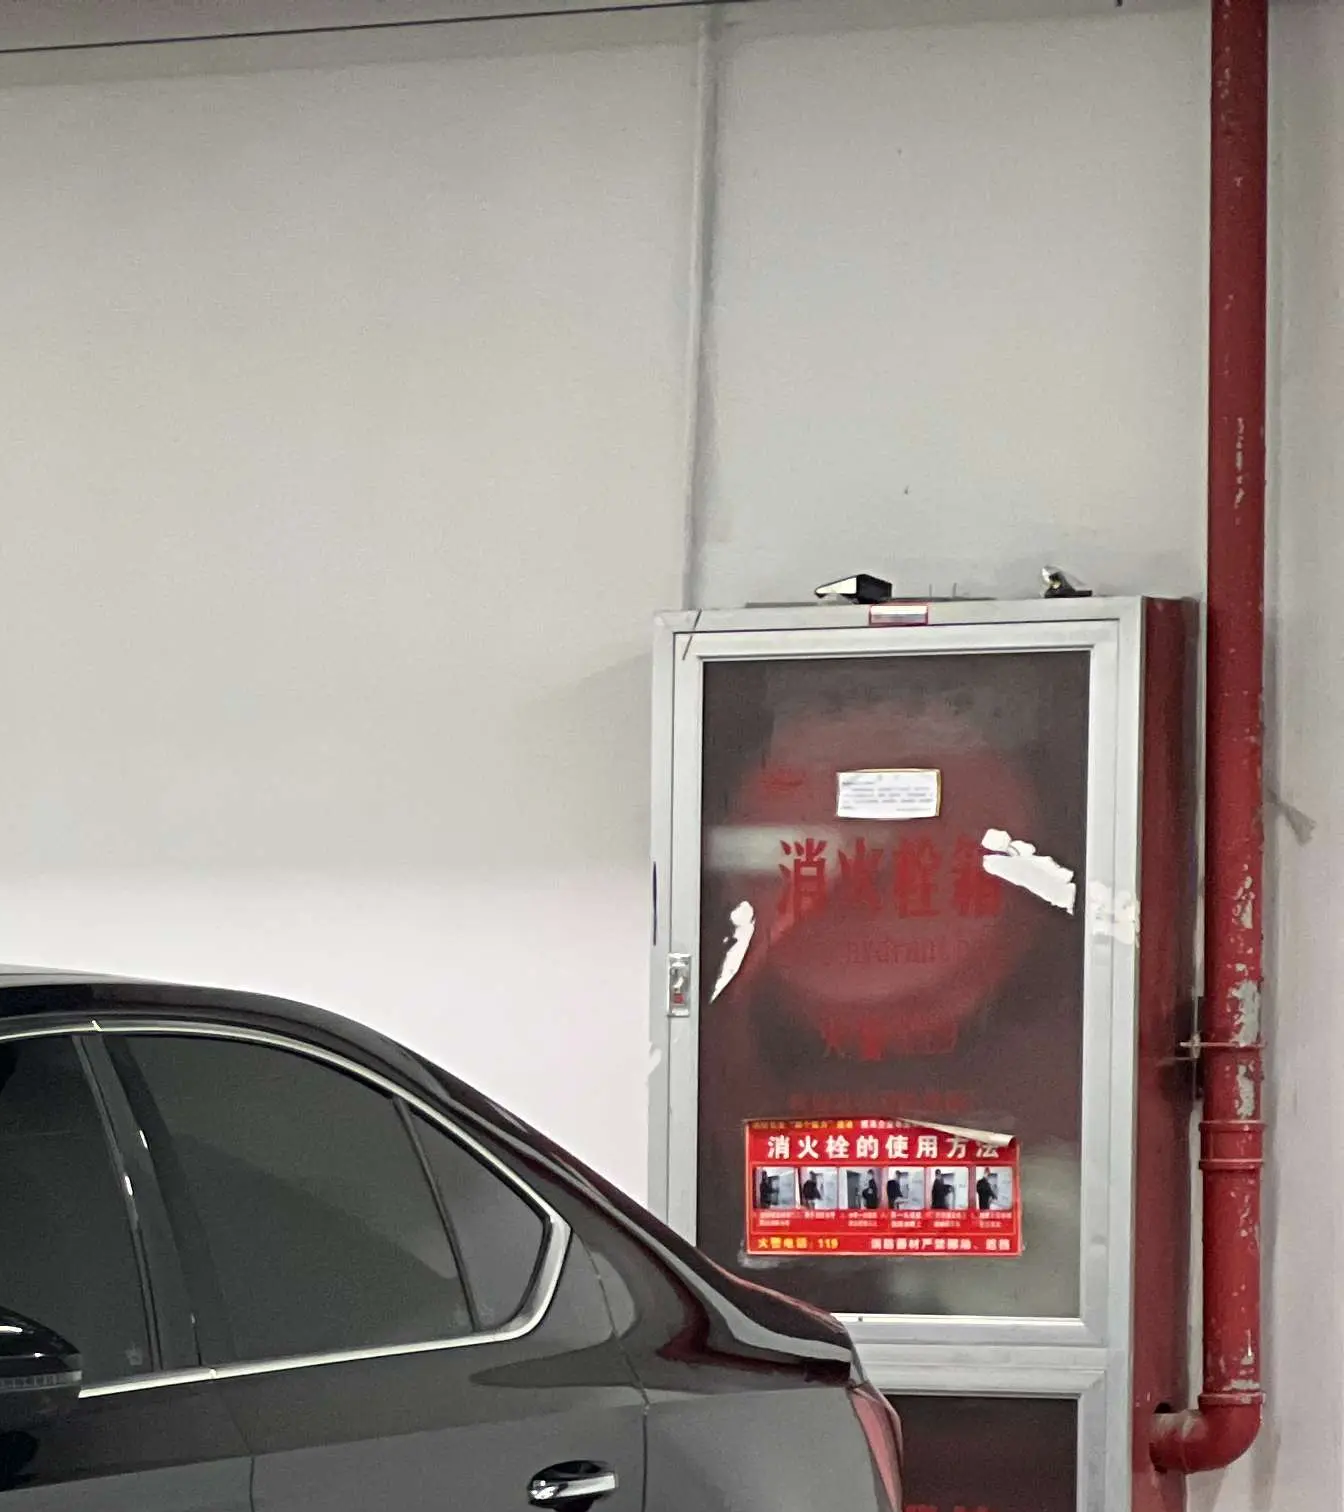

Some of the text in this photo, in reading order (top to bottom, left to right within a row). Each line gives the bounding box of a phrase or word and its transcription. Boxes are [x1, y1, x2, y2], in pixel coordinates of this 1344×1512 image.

[767, 1134, 1000, 1160] 消火栓的使用方法
